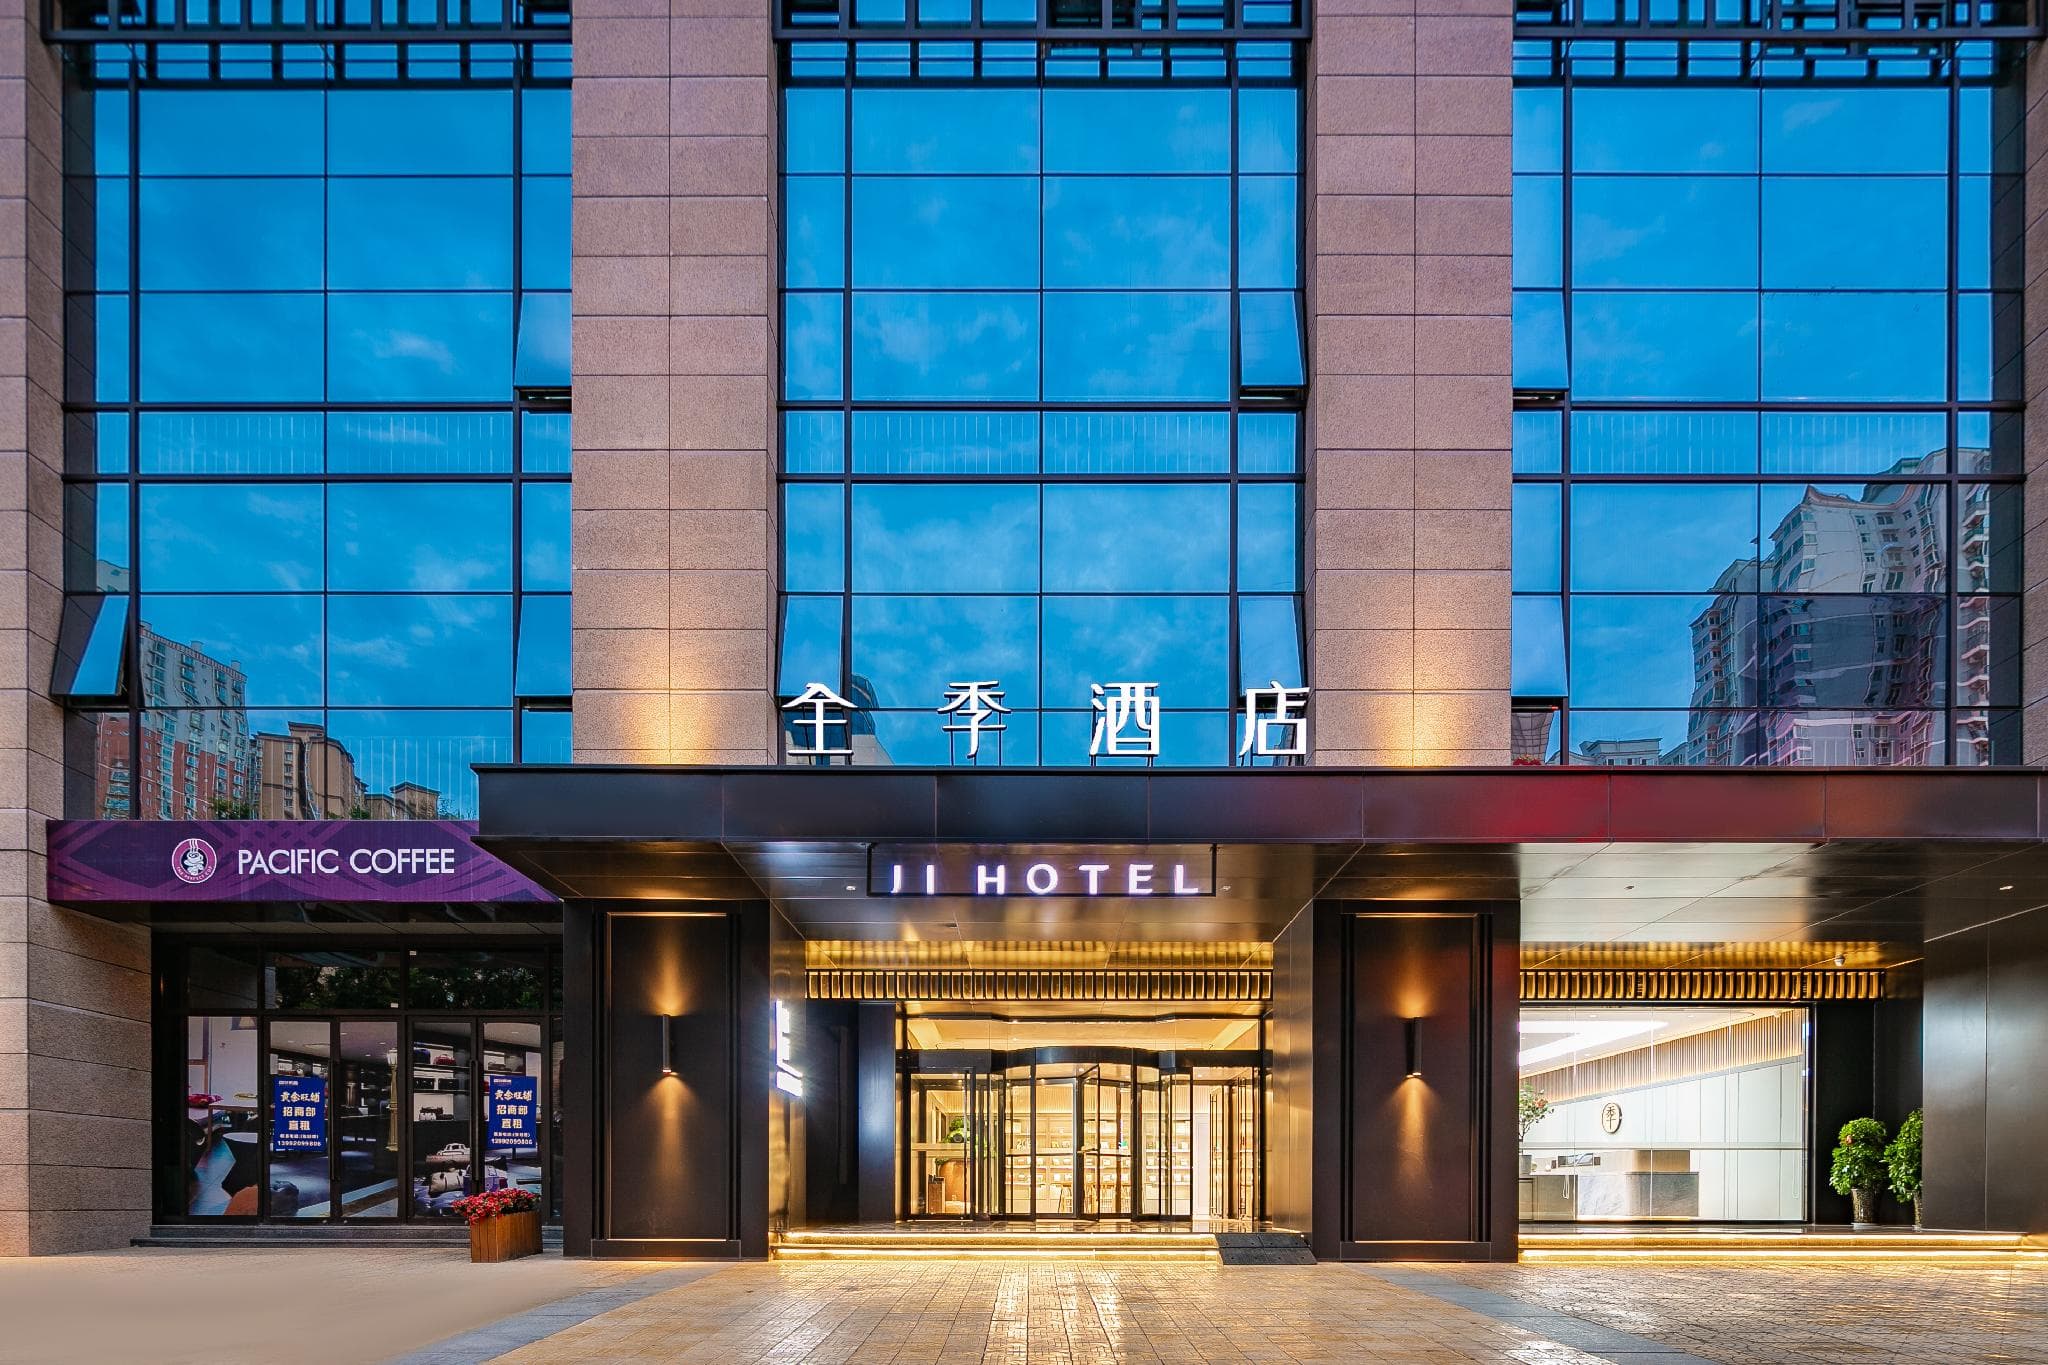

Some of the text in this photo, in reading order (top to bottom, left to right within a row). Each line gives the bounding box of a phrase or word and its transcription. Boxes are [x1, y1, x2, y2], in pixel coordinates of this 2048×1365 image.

[781, 681, 1310, 759] 全季酒店
[238, 848, 455, 875] PACIFIC COFFEE
[890, 863, 1199, 895] JI HOTEL
